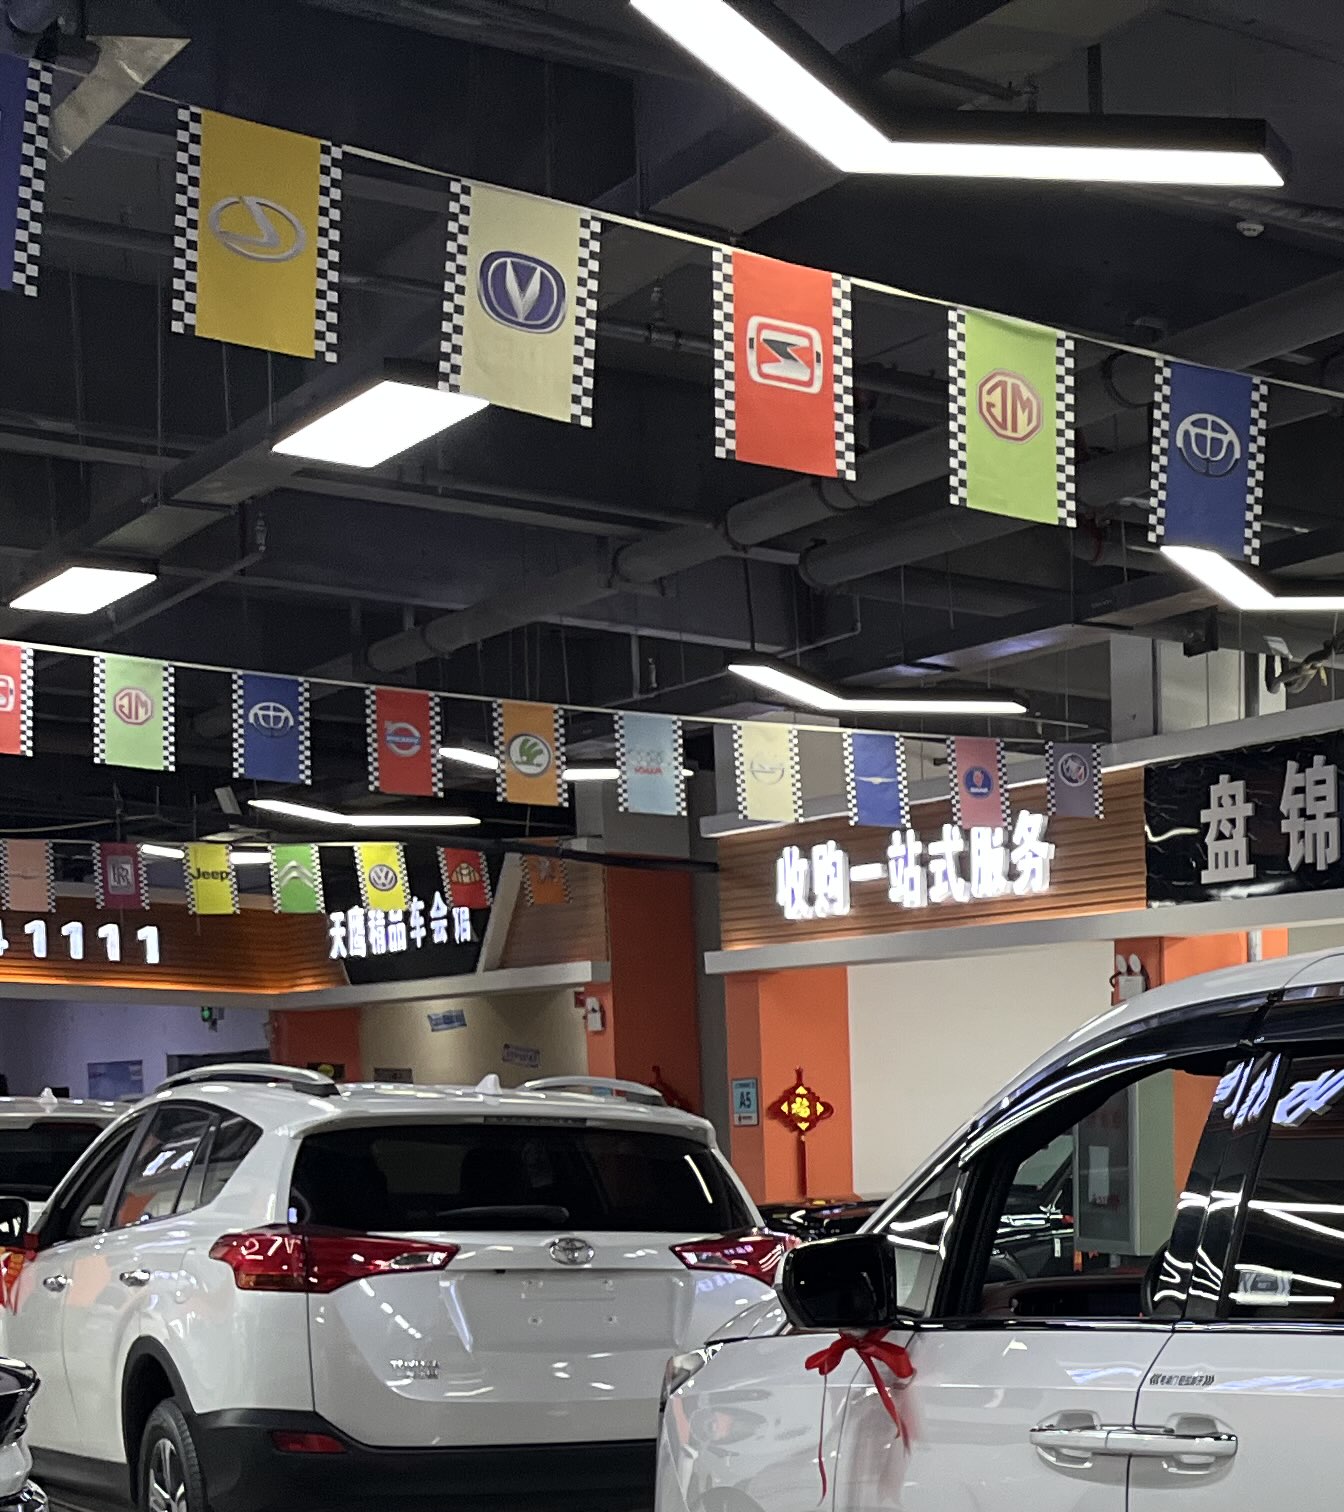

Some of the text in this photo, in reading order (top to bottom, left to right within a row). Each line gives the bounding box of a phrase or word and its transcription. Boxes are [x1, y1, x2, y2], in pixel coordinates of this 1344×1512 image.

[192, 867, 231, 883] Jeep
[775, 809, 1056, 920] 收购一站式服务
